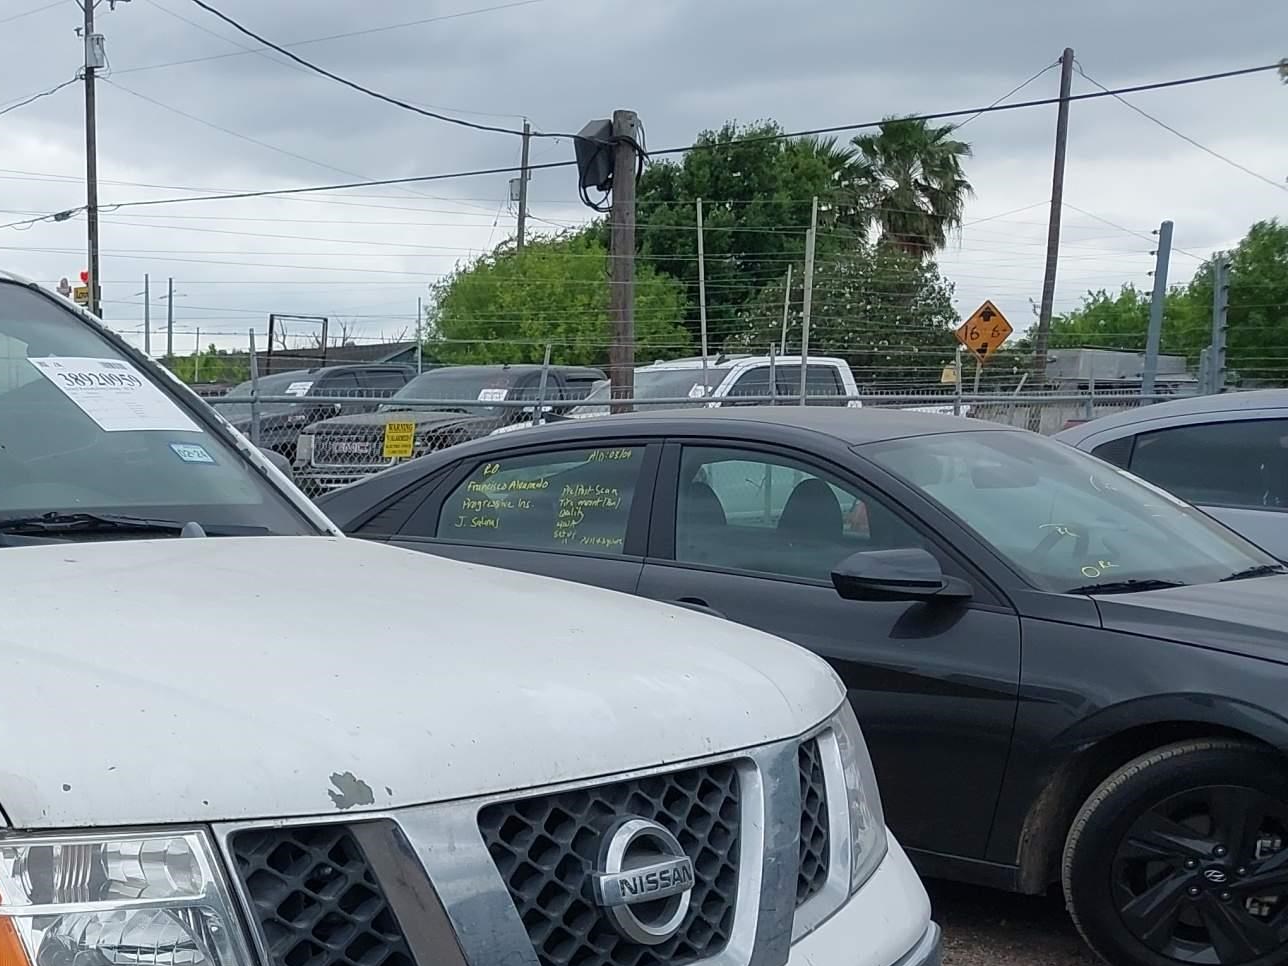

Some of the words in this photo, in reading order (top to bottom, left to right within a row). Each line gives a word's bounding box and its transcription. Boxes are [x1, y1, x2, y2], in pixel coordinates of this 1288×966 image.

[964, 324, 980, 341] 16
[56, 372, 143, 387] 38920959
[618, 863, 693, 897] NISSAN
